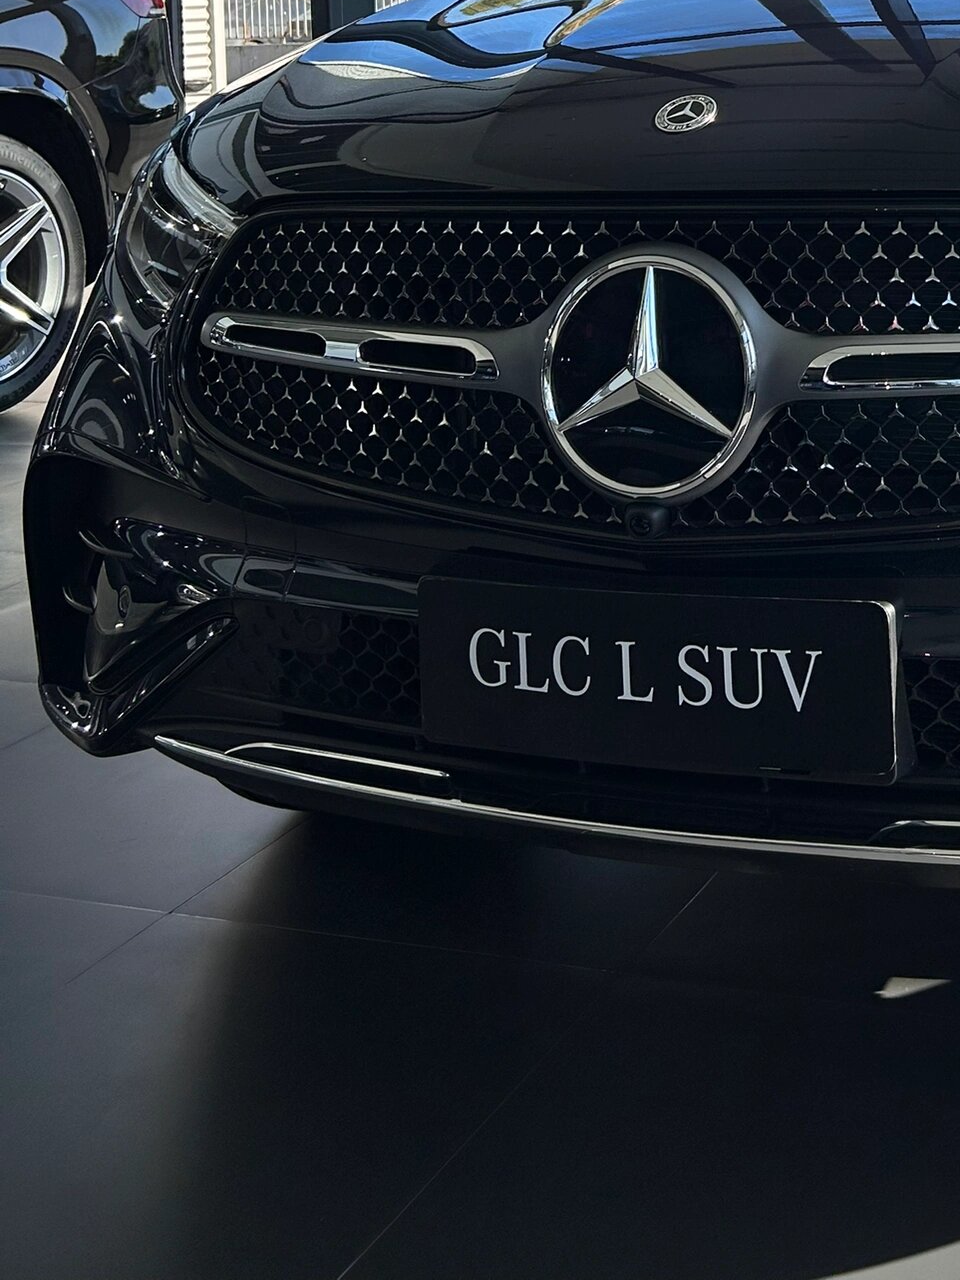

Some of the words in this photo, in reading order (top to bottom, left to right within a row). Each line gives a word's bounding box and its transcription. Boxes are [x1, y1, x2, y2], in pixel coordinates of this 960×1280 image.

[470, 627, 591, 697] GLC
[615, 640, 655, 703] L
[678, 645, 823, 713] SUV
